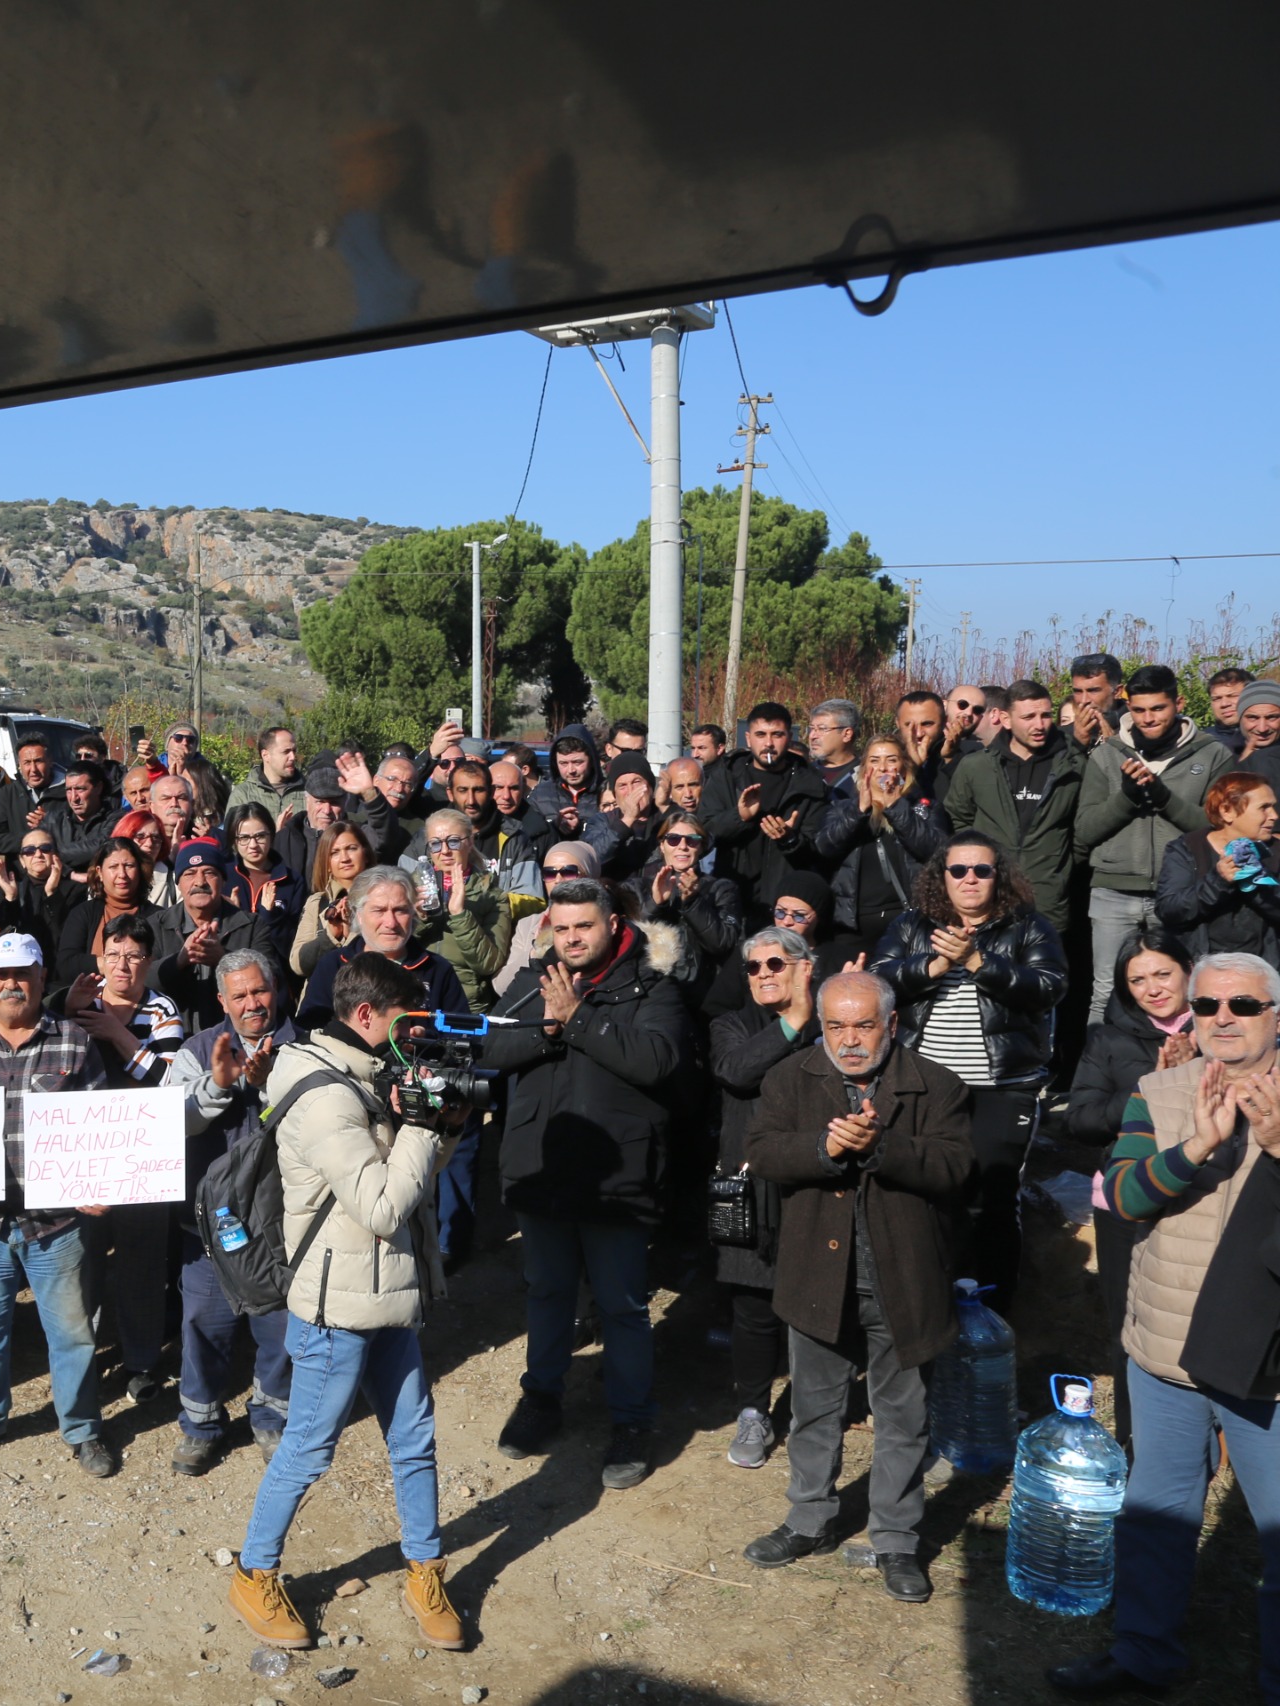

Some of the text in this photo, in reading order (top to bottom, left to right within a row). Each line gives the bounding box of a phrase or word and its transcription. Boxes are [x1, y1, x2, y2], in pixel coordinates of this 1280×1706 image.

[29, 1096, 156, 1126] MAL MÜLK
[33, 1128, 152, 1154] HALKINDIR
[27, 1154, 184, 1181] DEVLET SADECE
